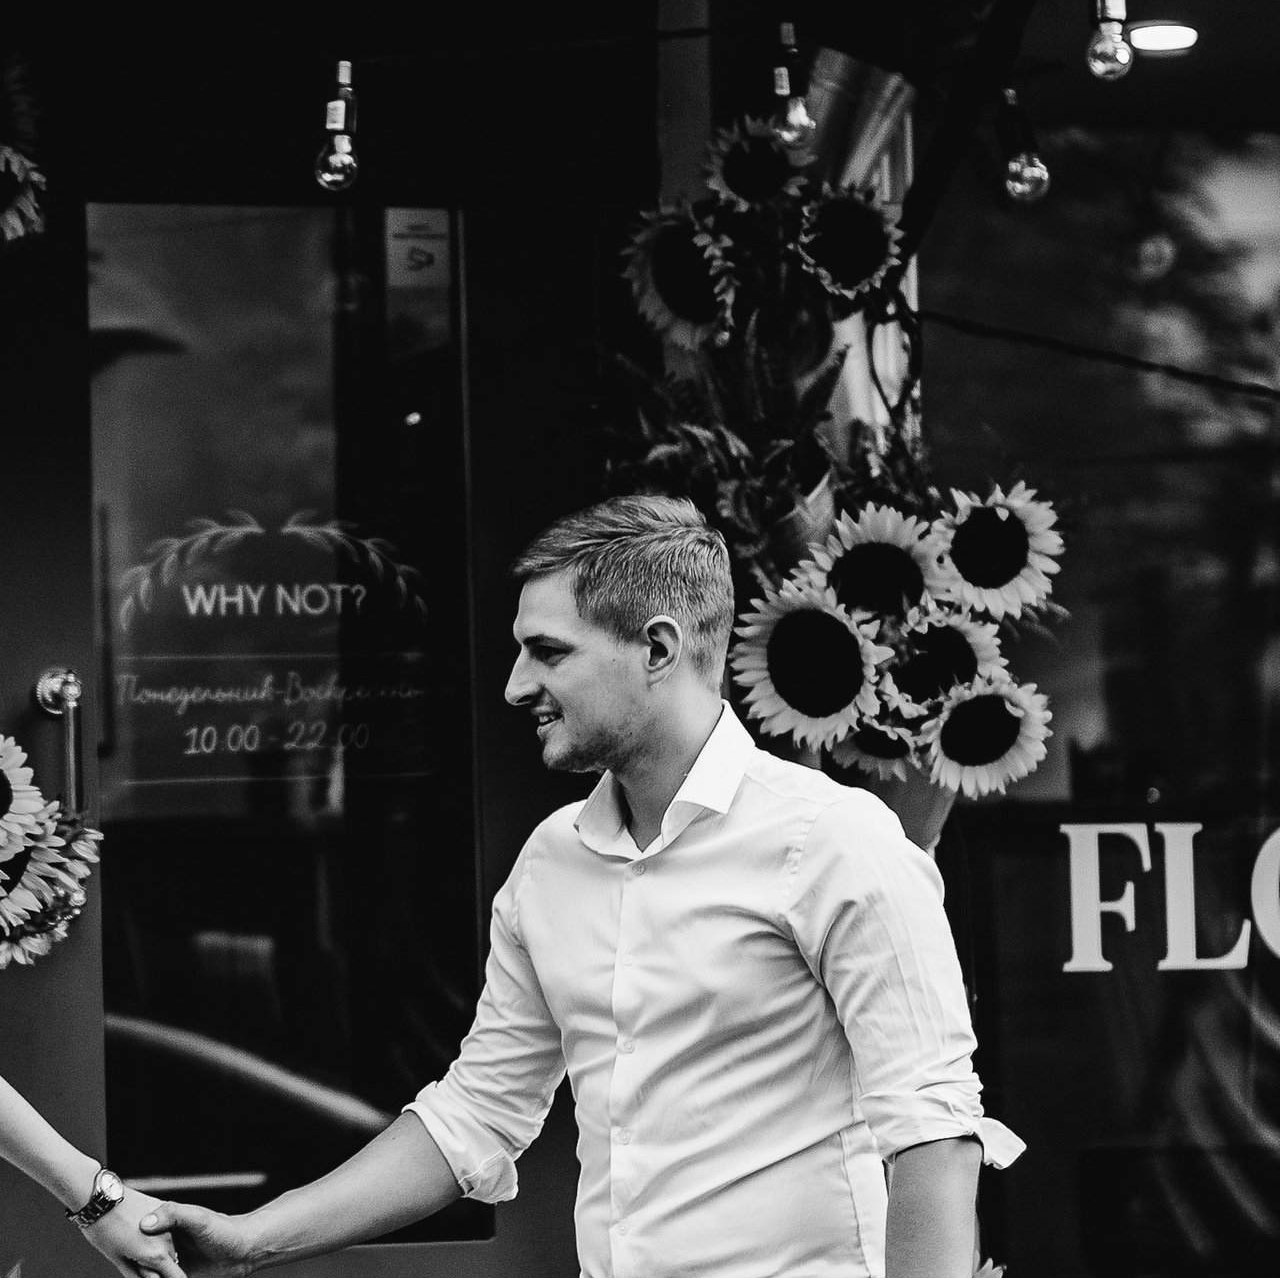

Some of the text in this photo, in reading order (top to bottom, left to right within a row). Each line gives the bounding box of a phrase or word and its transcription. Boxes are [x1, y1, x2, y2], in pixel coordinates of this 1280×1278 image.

[183, 584, 367, 616] WHY NOT?
[1059, 821, 1280, 973] FL
